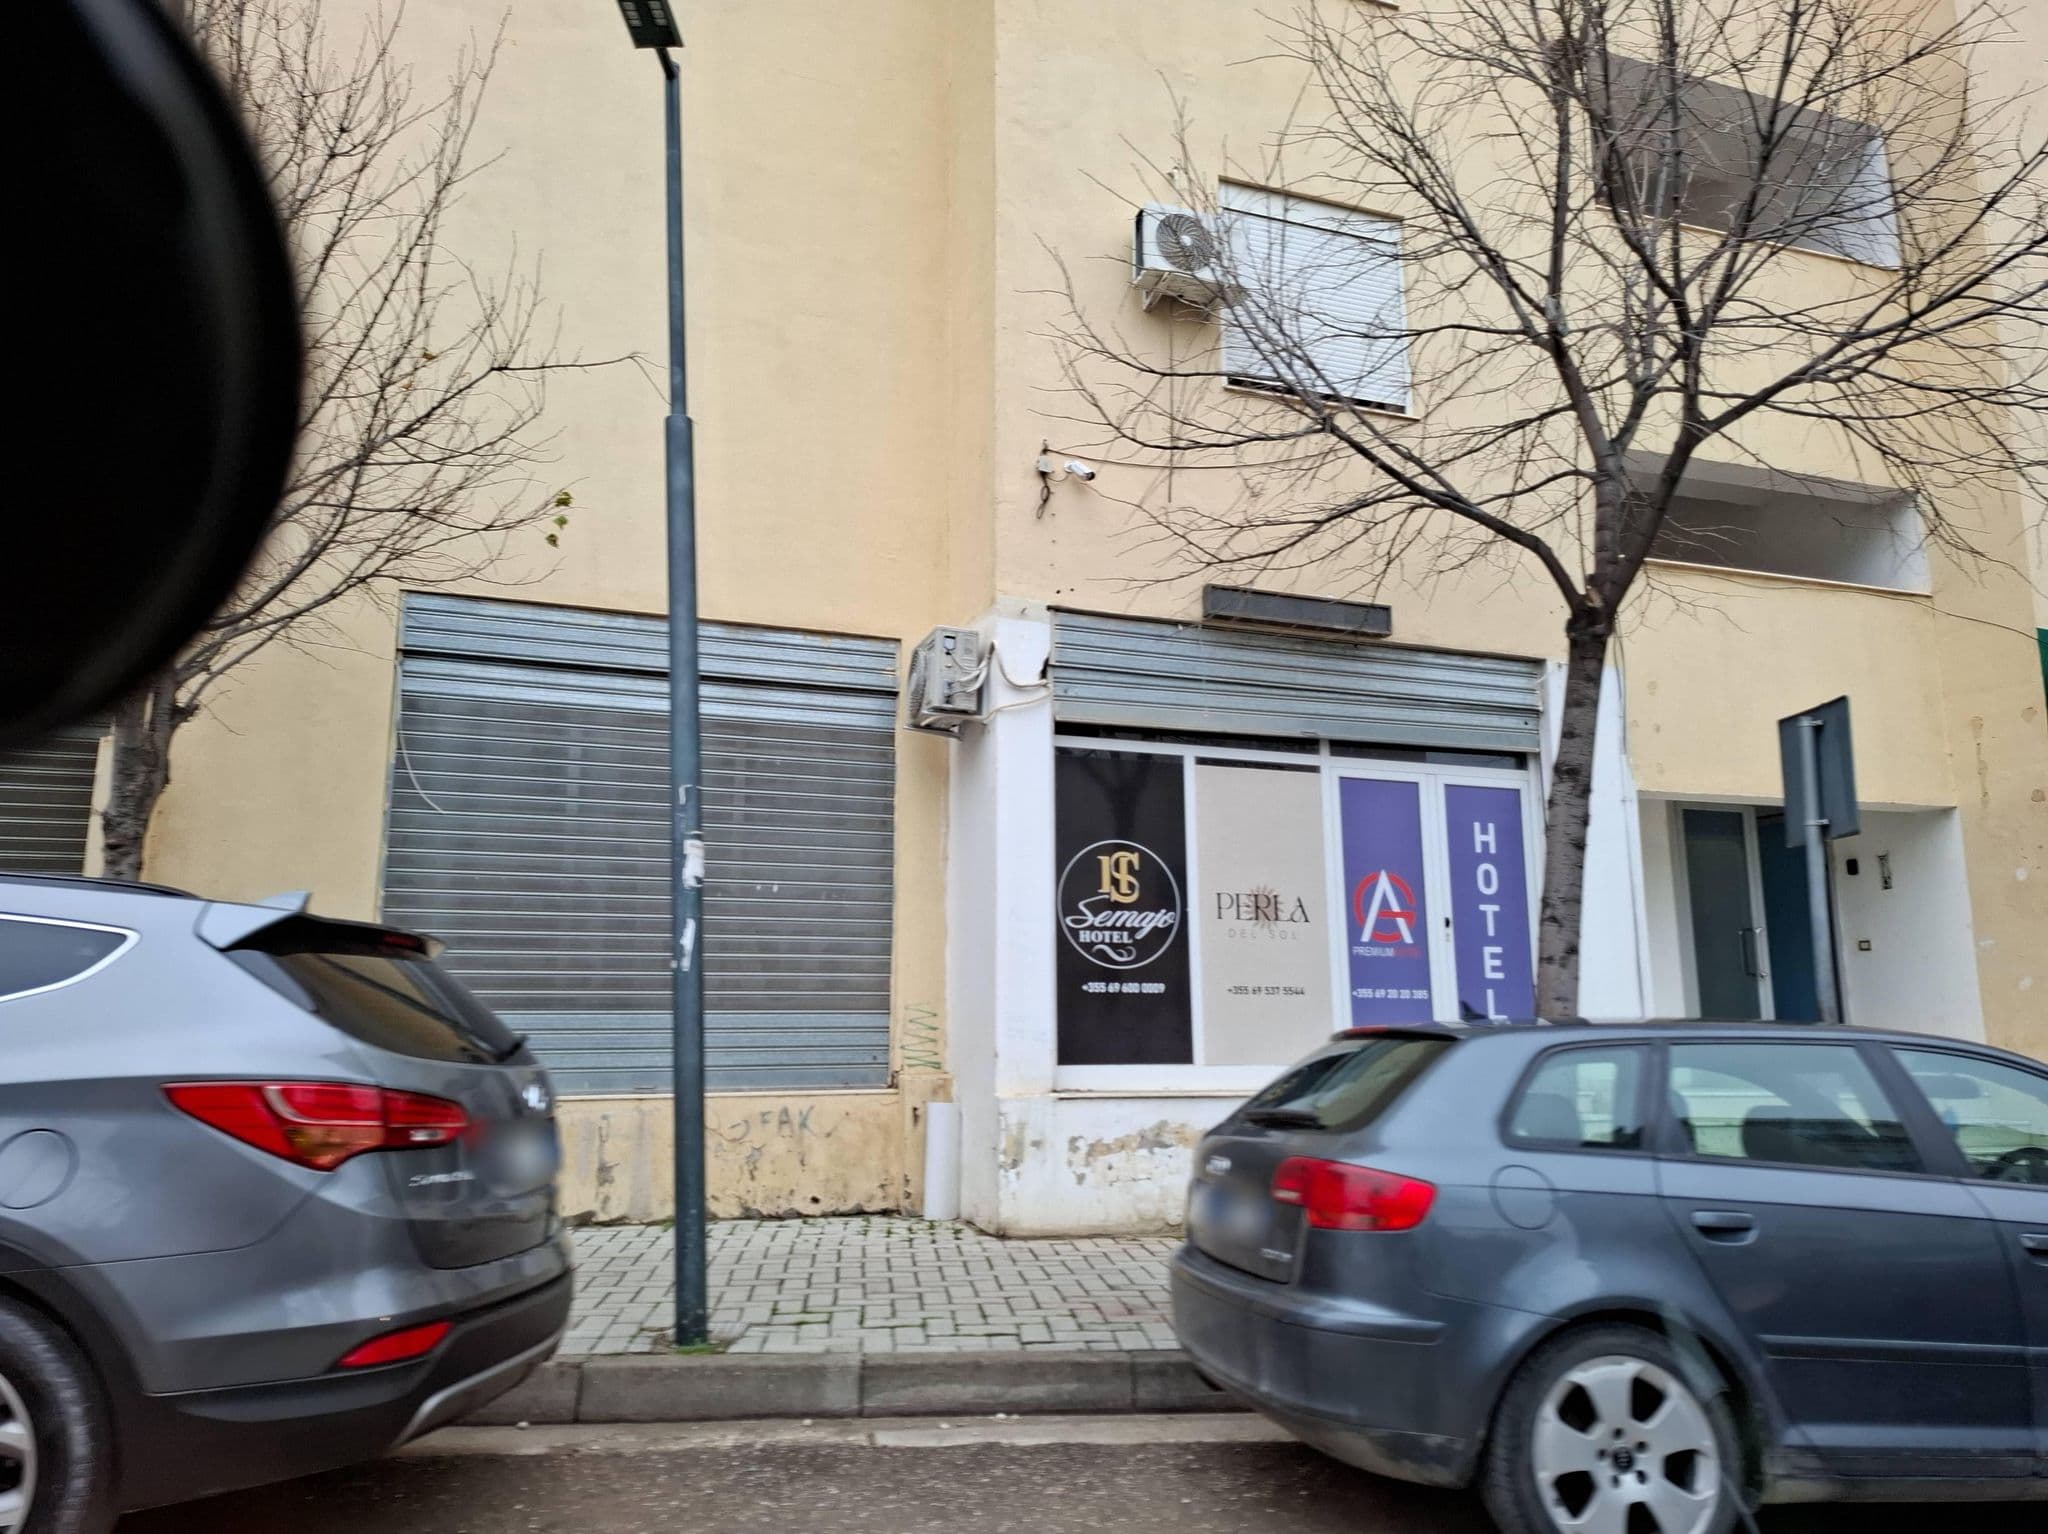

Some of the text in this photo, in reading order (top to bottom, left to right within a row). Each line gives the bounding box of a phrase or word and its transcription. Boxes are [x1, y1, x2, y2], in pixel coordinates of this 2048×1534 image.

[1216, 892, 1311, 923] PERLA
[1473, 822, 1508, 1020] HOTEL
[1079, 930, 1133, 944] HOTEL
